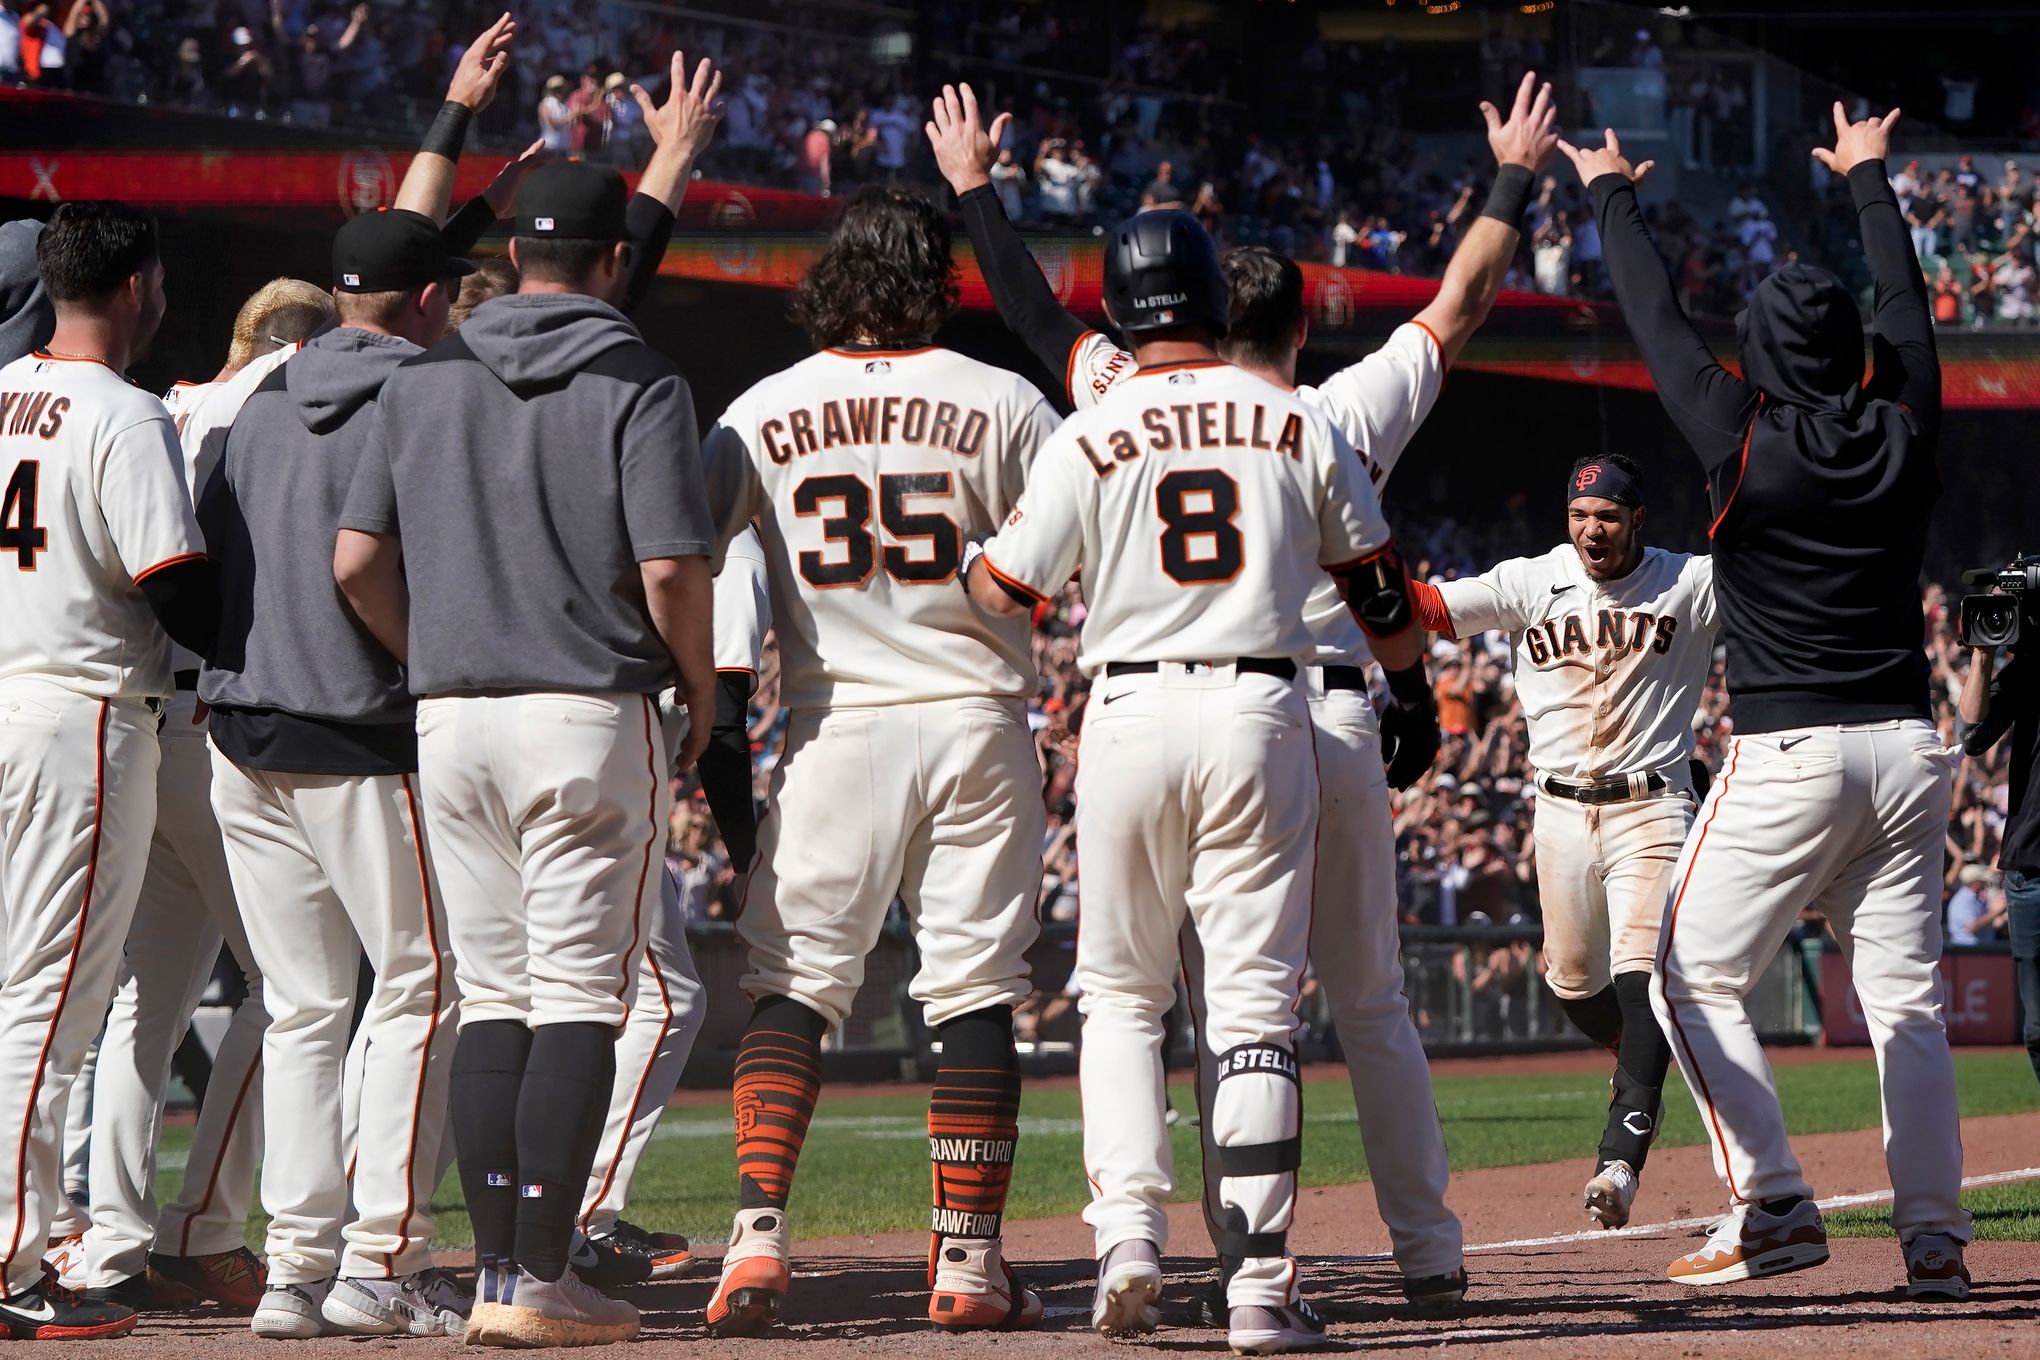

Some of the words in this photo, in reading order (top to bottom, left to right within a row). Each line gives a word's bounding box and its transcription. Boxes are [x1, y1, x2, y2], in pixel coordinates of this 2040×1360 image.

[1133, 298, 1147, 309] La
[1148, 291, 1188, 308] STELLA
[760, 396, 991, 467] CRAWFORD
[1076, 428, 1142, 480] La
[1141, 401, 1304, 464] STELLA
[0, 459, 48, 572] 4
[792, 470, 963, 591] 35
[1155, 467, 1246, 588] 8
[1525, 609, 1678, 667] GIANTS
[1232, 1048, 1297, 1079] STELLA
